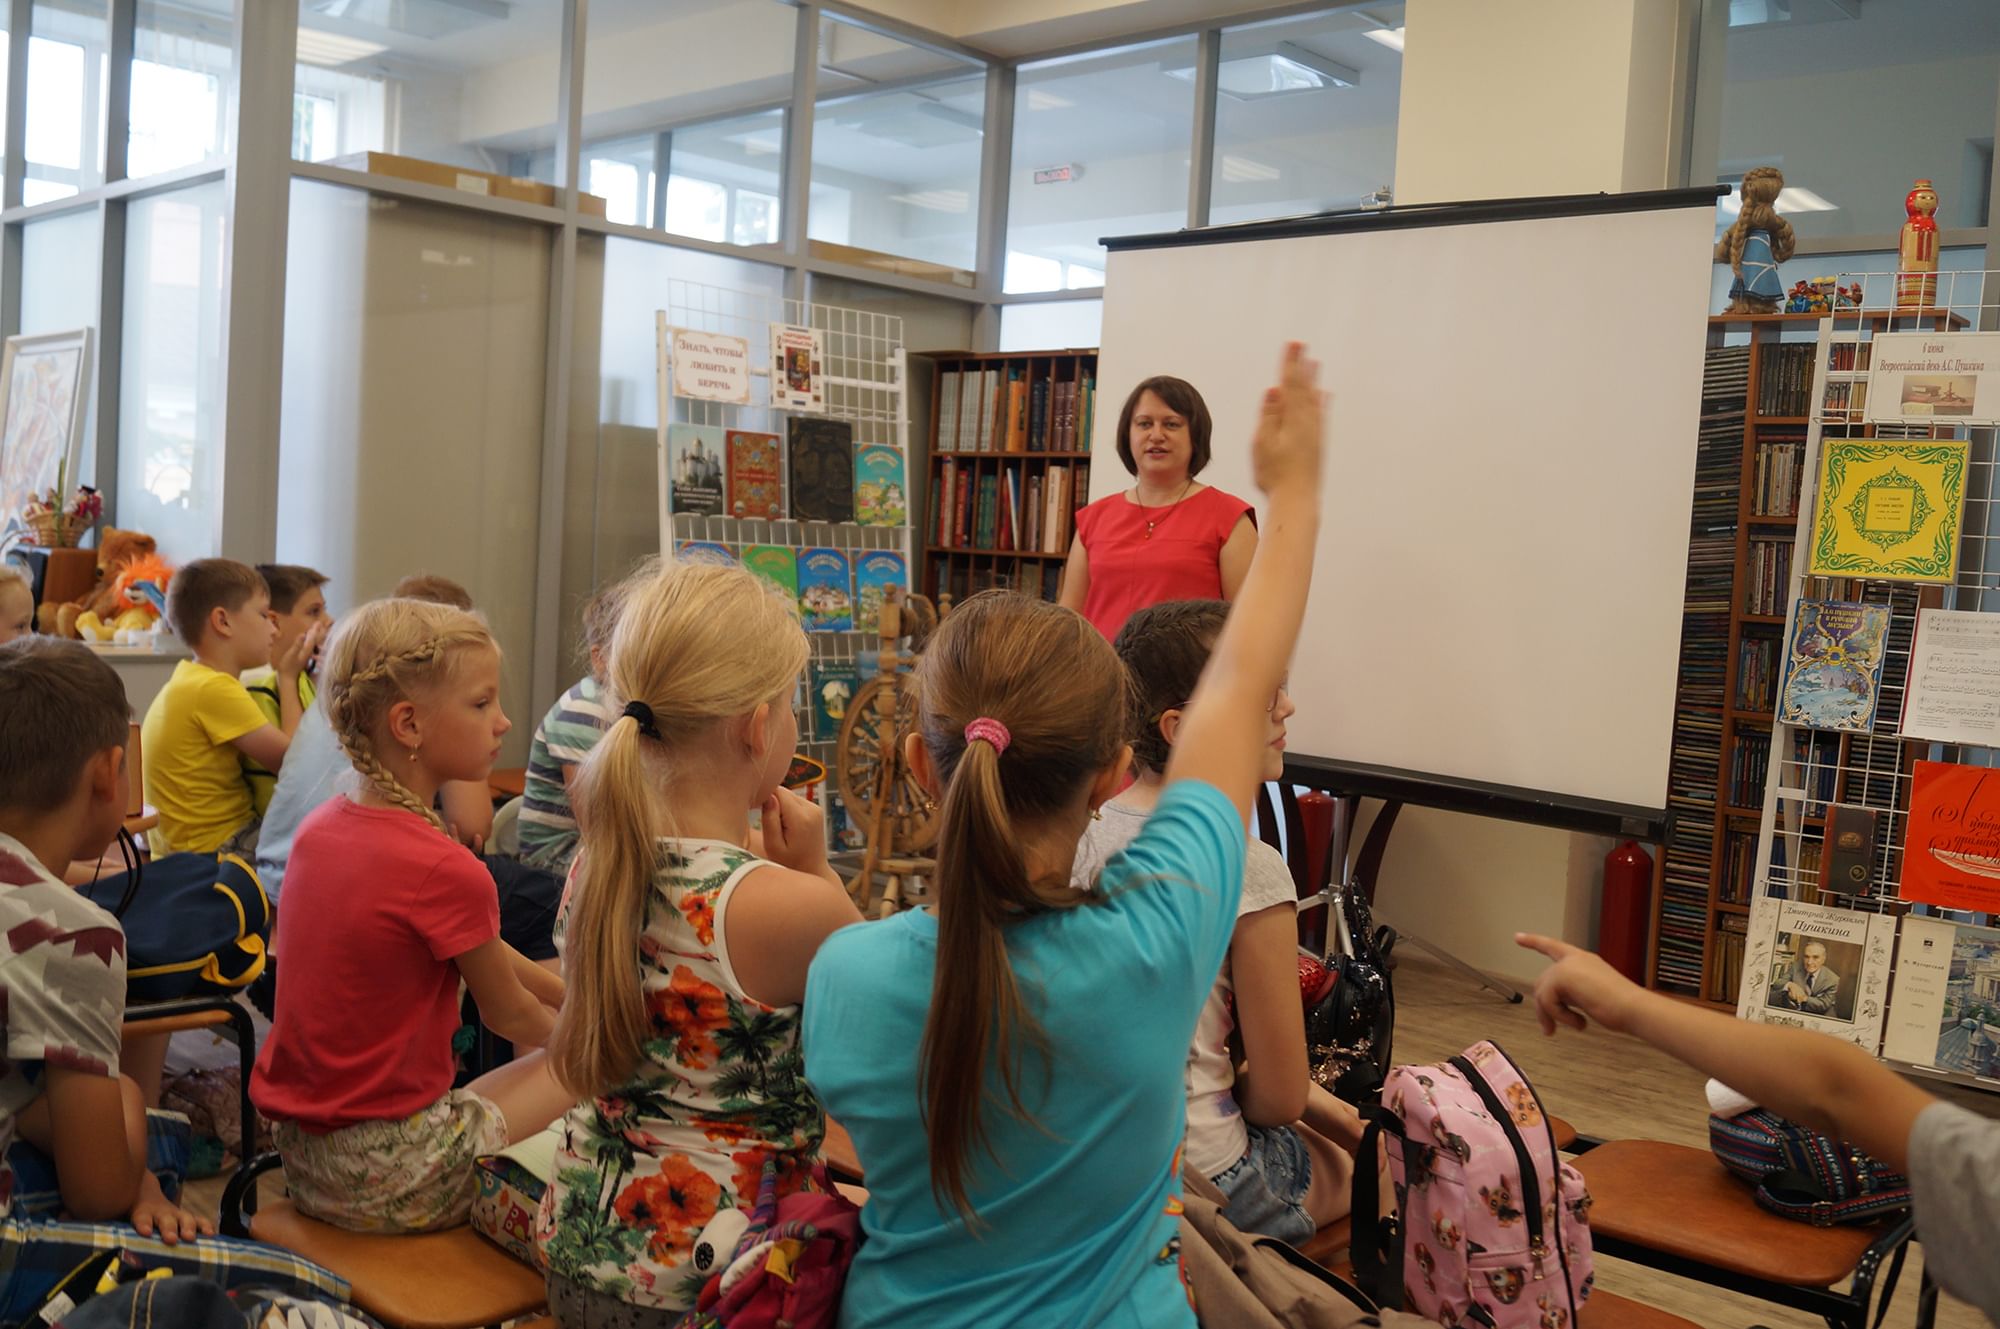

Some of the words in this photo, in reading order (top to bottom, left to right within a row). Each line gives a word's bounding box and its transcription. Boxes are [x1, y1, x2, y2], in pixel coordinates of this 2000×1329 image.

[1954, 359, 1984, 373] Пушкина
[1784, 906, 1824, 919] Дмитрий
[1793, 920, 1850, 937] Пушкина
